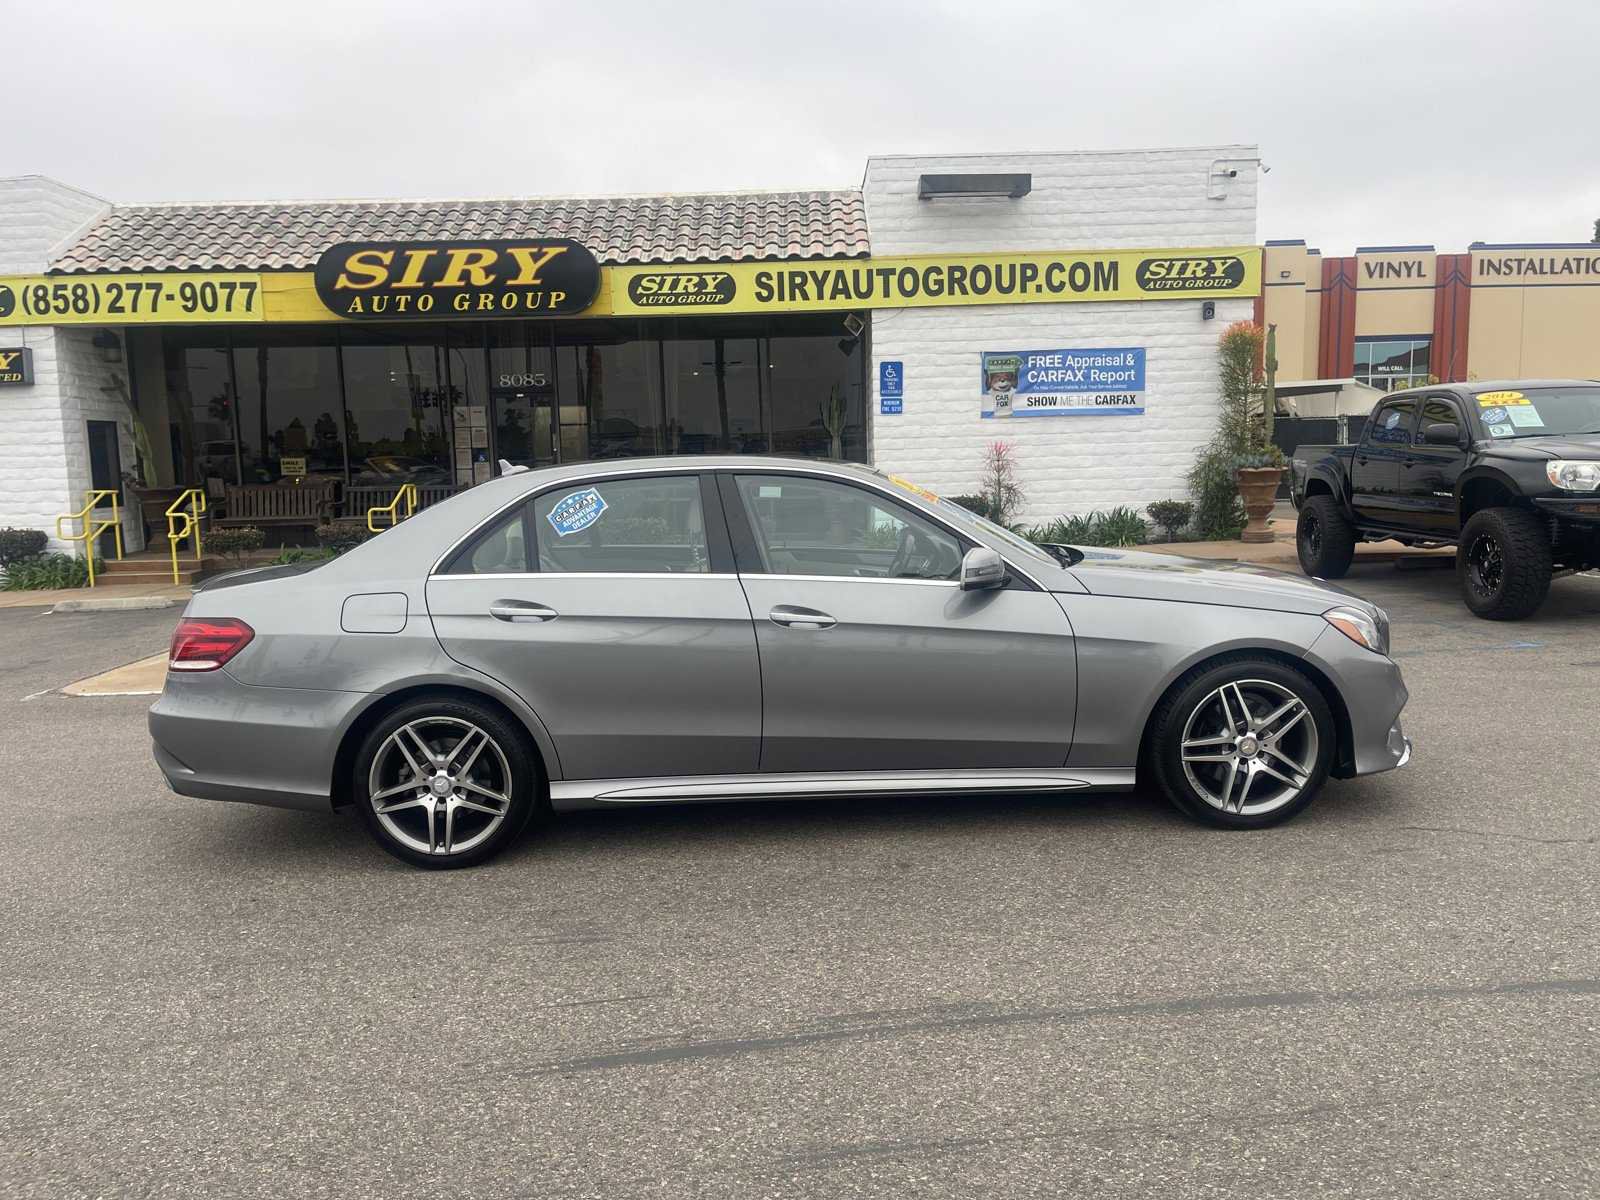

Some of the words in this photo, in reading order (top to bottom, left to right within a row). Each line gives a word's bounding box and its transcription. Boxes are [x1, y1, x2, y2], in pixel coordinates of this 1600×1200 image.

[333, 246, 570, 291] SIRY
[1143, 258, 1238, 279] SIRY
[1365, 261, 1427, 279] VINYL
[636, 274, 728, 295] SIRY
[754, 260, 1119, 303] SIRYAUTOGROUP.COM
[1145, 280, 1183, 289] AUTO
[1185, 278, 1233, 288] GROUP
[347, 294, 435, 313] AUTO
[453, 291, 567, 311] GROUP
[638, 295, 676, 304] AUTO
[678, 294, 725, 304] GROUP
[1028, 355, 1063, 368] FREE
[1065, 353, 1124, 371] Appraisal
[1126, 353, 1135, 366] &
[500, 373, 546, 388] 8085
[1090, 368, 1136, 384] Report
[1027, 396, 1058, 407] SHOW
[1095, 394, 1136, 406] CARFAX
